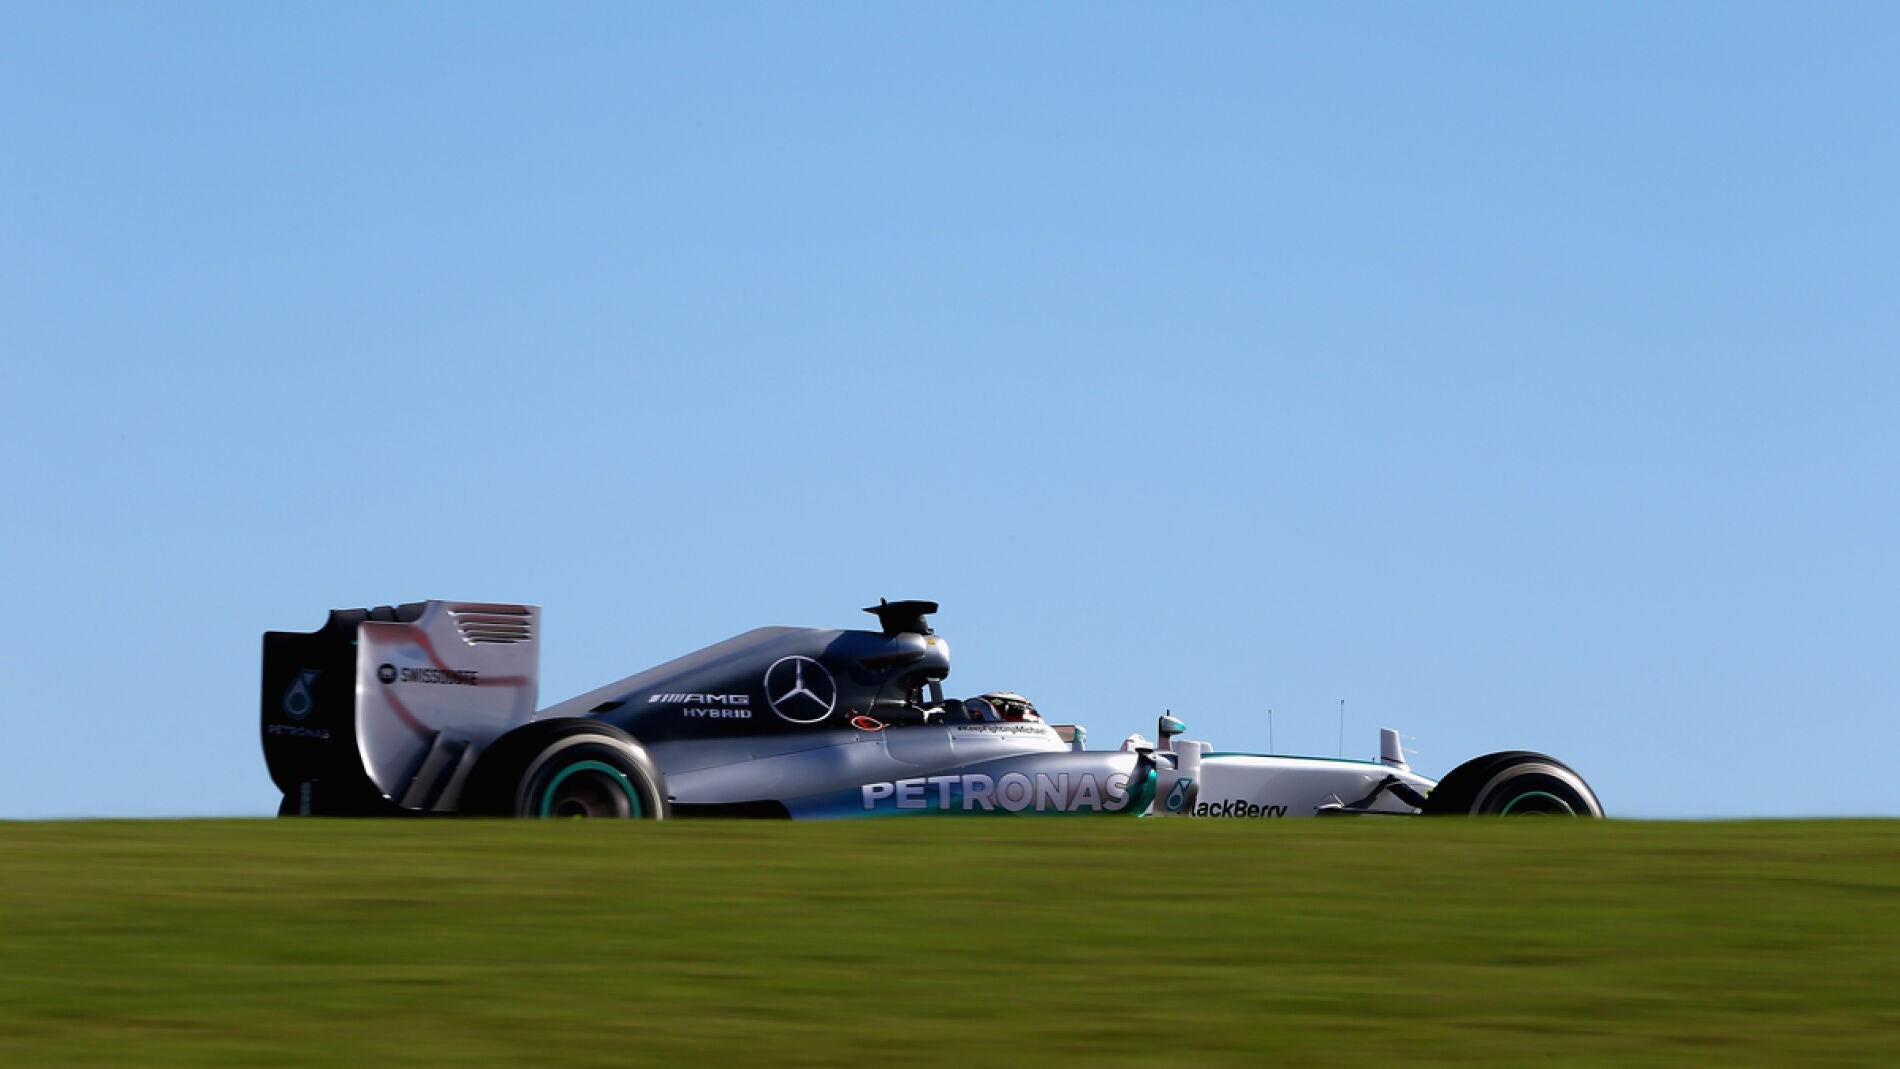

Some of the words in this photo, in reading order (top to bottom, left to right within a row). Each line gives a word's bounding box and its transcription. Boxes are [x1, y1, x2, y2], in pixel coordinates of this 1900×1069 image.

[683, 707, 752, 719] HYBRID
[861, 772, 1130, 812] PETRONAS
[1190, 799, 1288, 818] lackBerry
